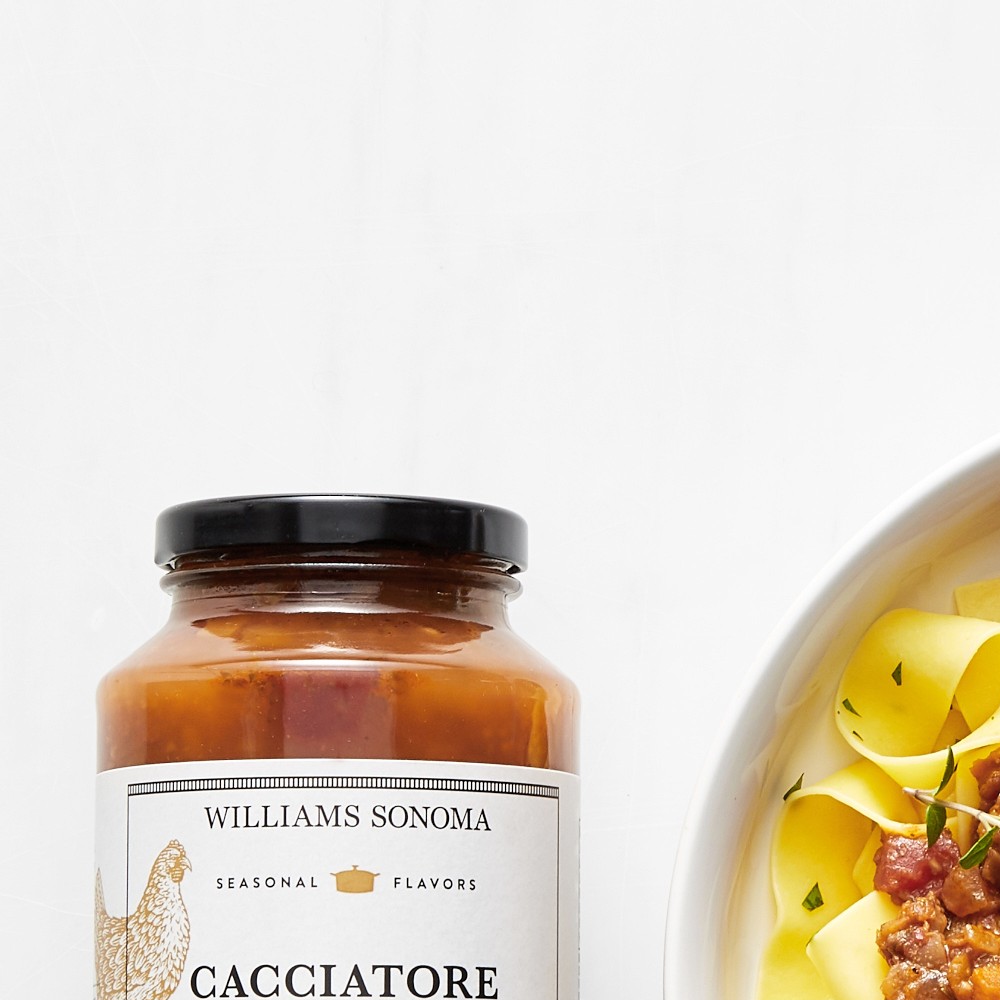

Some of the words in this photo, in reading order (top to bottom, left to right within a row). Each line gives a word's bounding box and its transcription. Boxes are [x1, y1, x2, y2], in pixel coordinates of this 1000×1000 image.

[204, 804, 361, 830] WILLIAMS
[371, 805, 492, 832] SONOMA
[216, 875, 318, 889] SEASONAL
[394, 877, 477, 891] FLAVORS
[190, 964, 499, 1000] CACCIATORE
